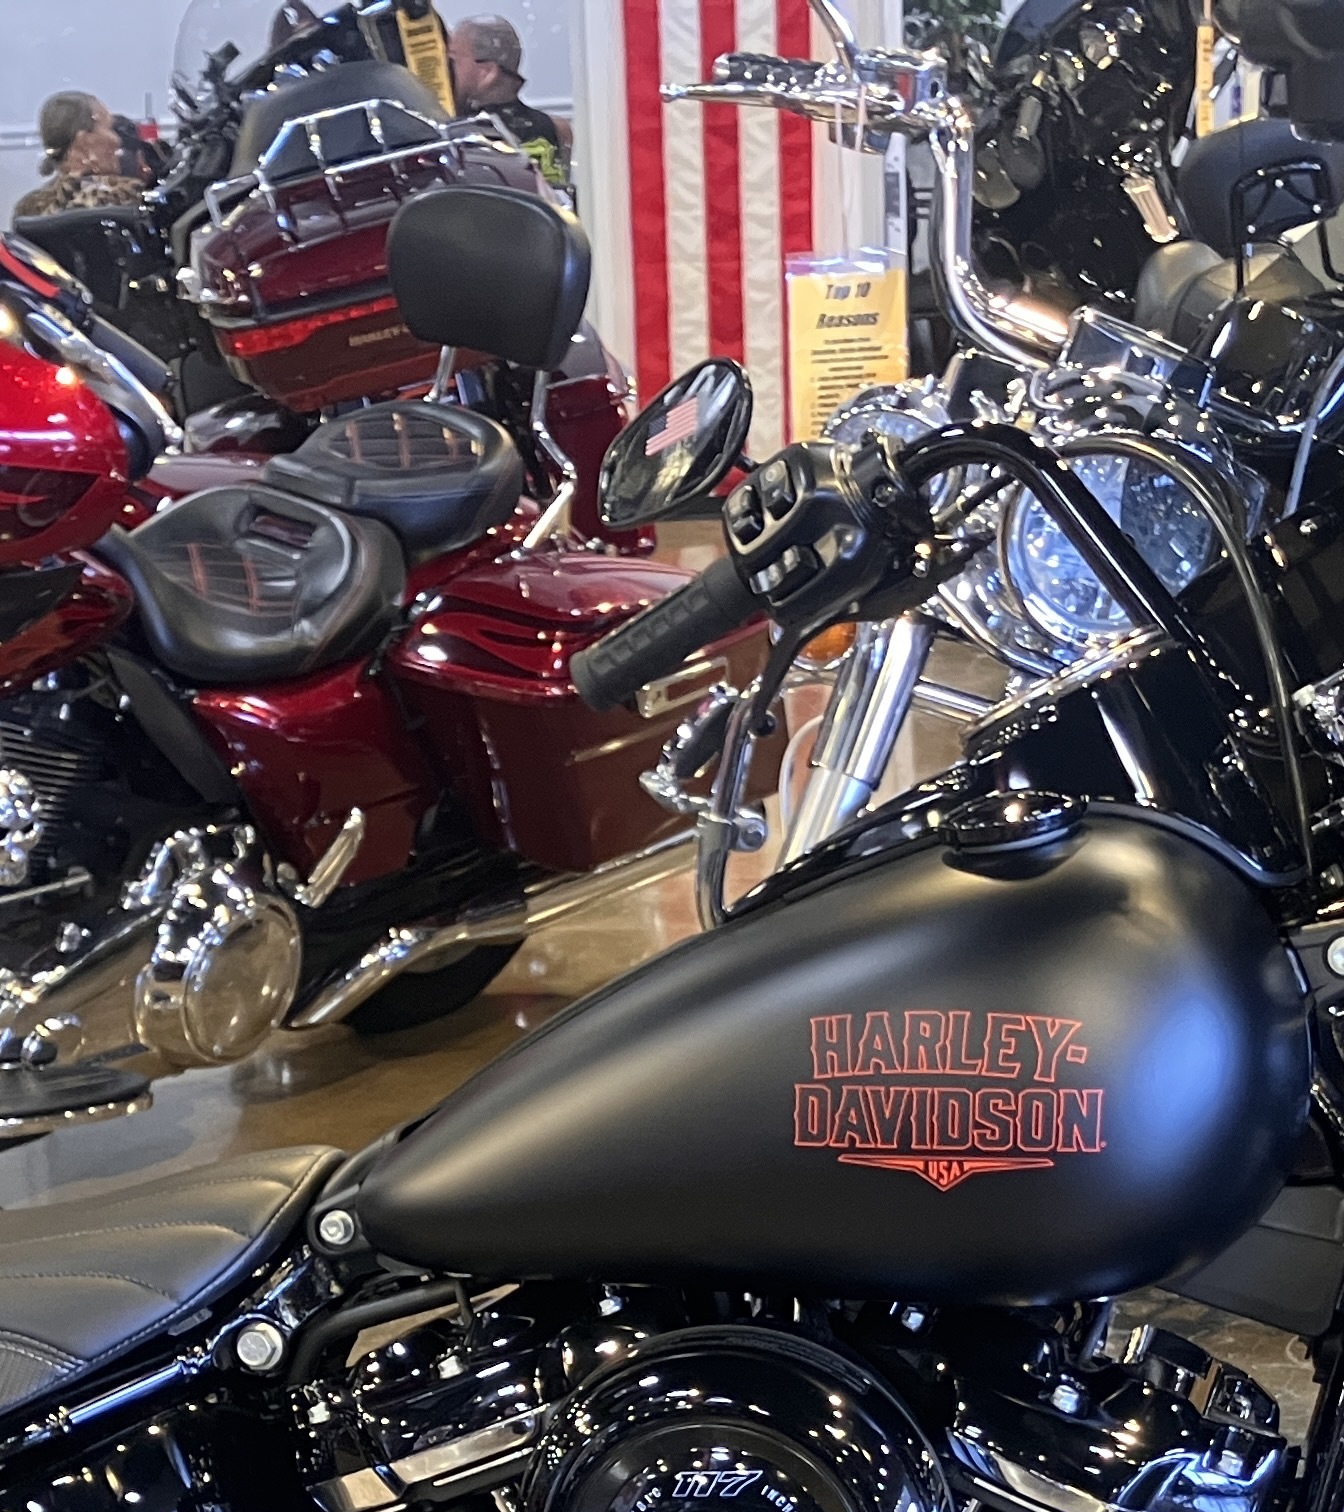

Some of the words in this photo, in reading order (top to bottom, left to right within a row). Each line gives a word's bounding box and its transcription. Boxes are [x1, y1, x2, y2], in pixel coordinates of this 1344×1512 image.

[816, 313, 880, 330] Reasons
[809, 1010, 1088, 1083] HARLEY-
[793, 1084, 1105, 1153] DAVIDSON
[928, 1160, 962, 1185] USA
[671, 1470, 764, 1498] 117
